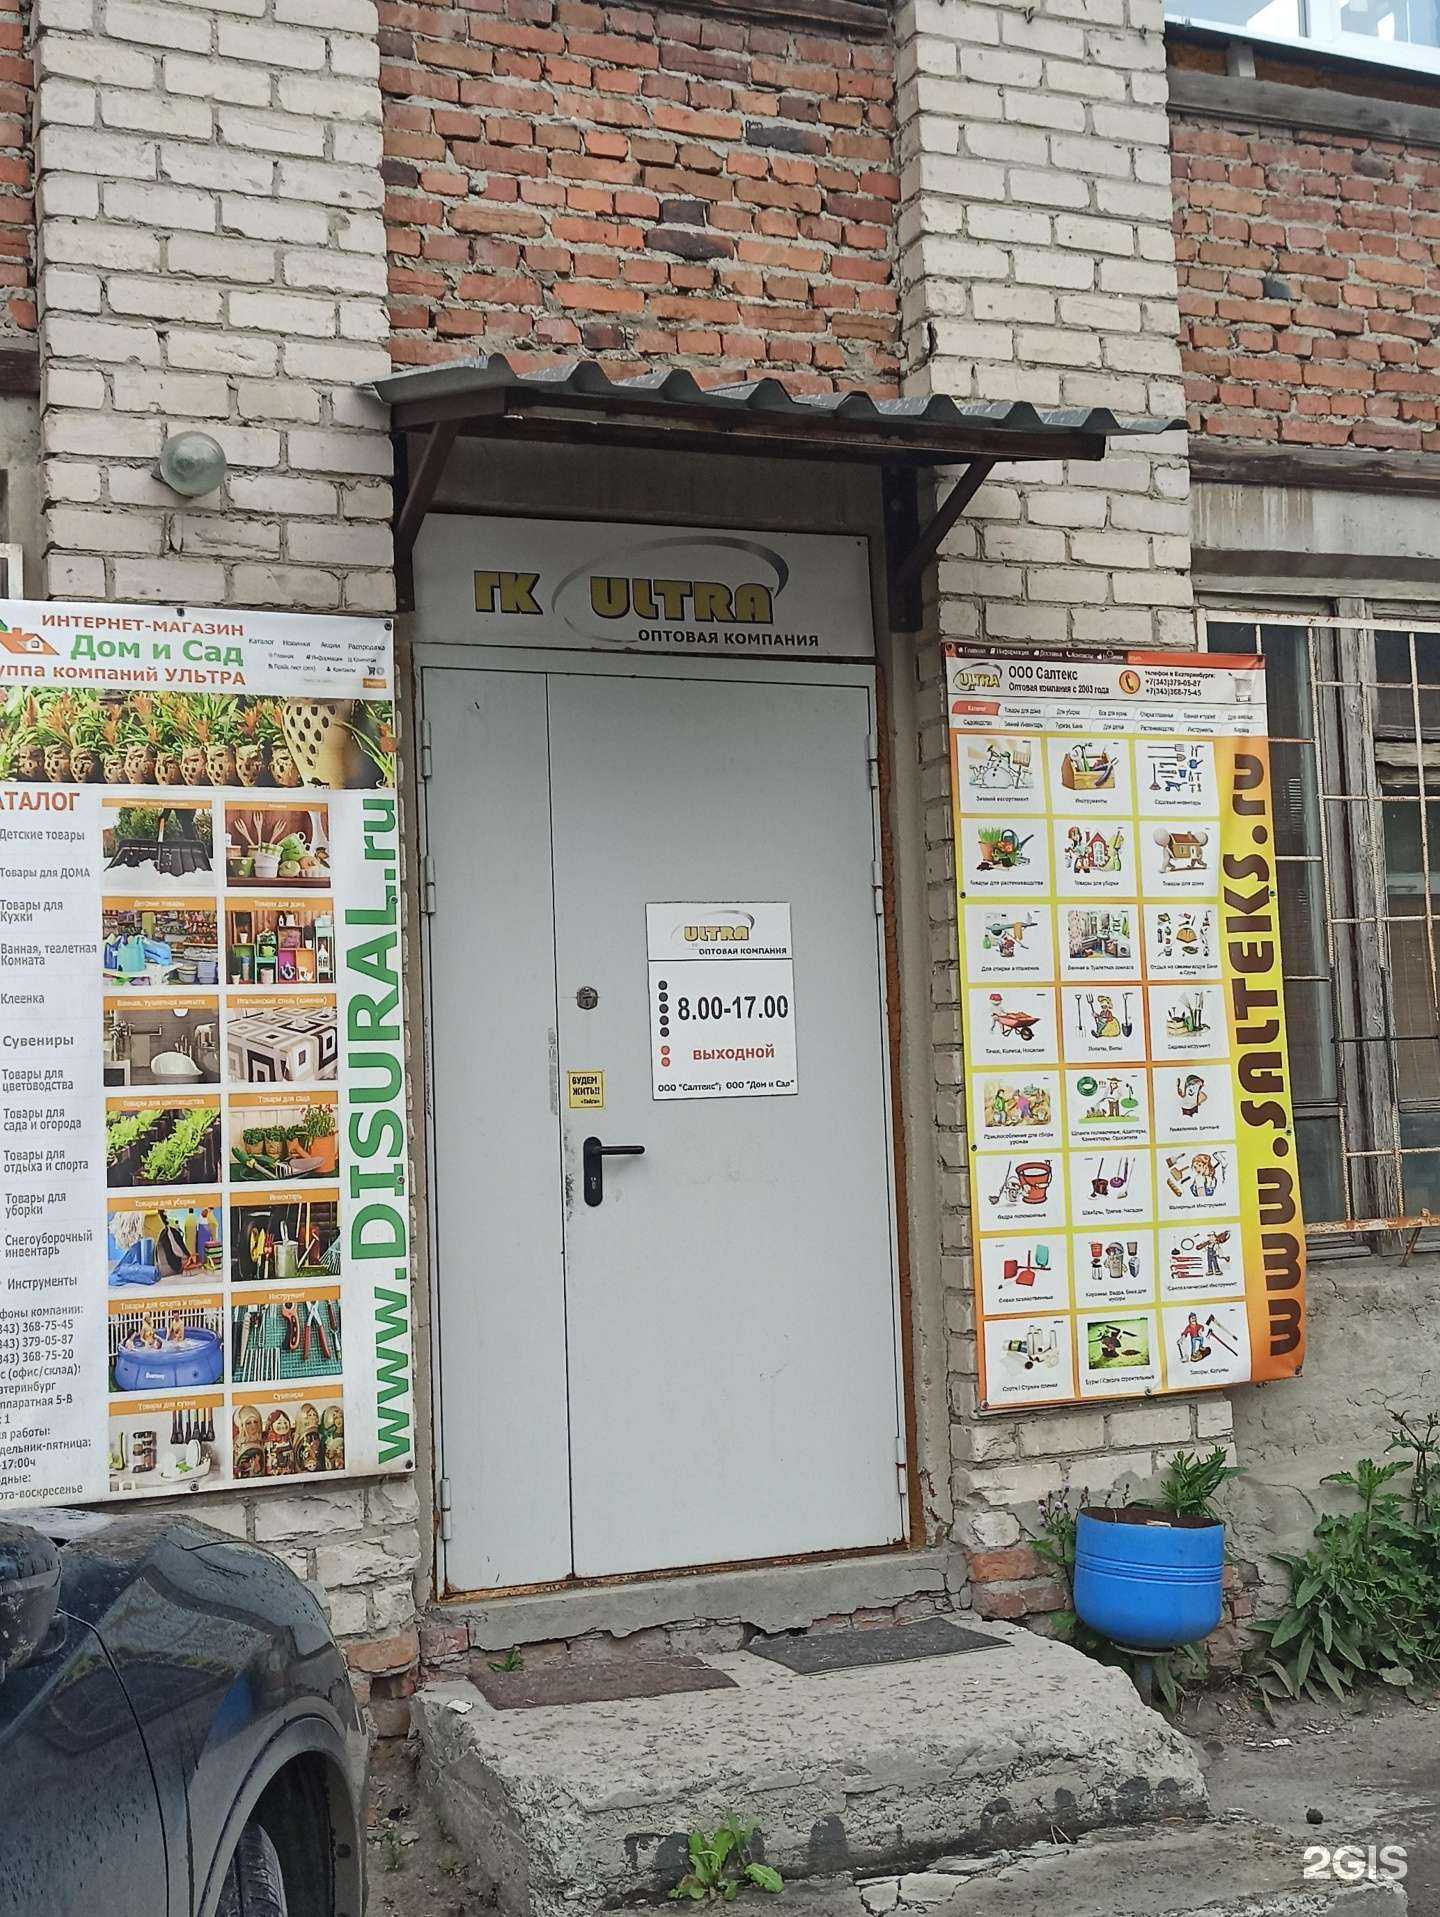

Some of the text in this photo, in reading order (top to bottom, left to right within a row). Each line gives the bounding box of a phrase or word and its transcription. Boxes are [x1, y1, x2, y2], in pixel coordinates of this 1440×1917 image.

[474, 569, 544, 616] ГК
[589, 575, 774, 625] ULTRA
[41, 613, 245, 637] ИНТЕРНЕТ-МАГАЗИН
[638, 629, 819, 647] ОПТОВАЯ КОМПАНИЯ
[69, 634, 244, 667] Дом и Сад
[55, 665, 158, 683] компаний
[165, 669, 246, 686] УЛЬТРА
[960, 672, 1001, 689] ULTRA
[1008, 665, 1079, 681] ООО Салтекс
[1008, 682, 1038, 692] Оптовая
[0, 828, 85, 843] Детские товары
[0, 867, 91, 880] Товары для ДОМА
[0, 899, 64, 912] Товары для
[683, 925, 750, 942] ULTRA
[1, 943, 42, 956] Ванная,
[698, 946, 788, 957] ОПТОВАЯ КОМПАНИЯ
[1, 955, 45, 966] Комната
[0, 993, 44, 1005] Клеенка
[677, 994, 789, 1021] 8.00-17.00
[2, 1034, 74, 1049] Сувениры
[692, 1043, 776, 1061] ВЫХОДНОЙ
[1223, 753, 1301, 1356] www.SALTEKS.ru
[2, 1068, 63, 1082] Товары для
[572, 1076, 598, 1086] БУДЕМ
[2, 1080, 74, 1093] цветоводства
[658, 1083, 677, 1092] ООО
[726, 1080, 745, 1090] ООО
[768, 1080, 774, 1089] и
[3, 1107, 65, 1121] Товары для
[3, 1118, 82, 1132] сада и огорода
[345, 796, 408, 1465] www.DISURAL.ru
[3, 1148, 65, 1163] Товары для
[4, 1159, 89, 1175] отдыха и спорта
[5, 1192, 67, 1206] Товары для
[5, 1204, 43, 1219] уборки
[5, 1229, 93, 1248] Снегоуборочный
[5, 1246, 60, 1259] инвентарь
[7, 1275, 78, 1292] Инструменты
[30, 1305, 84, 1319] компании:
[22, 1319, 74, 1334] 368-75-45
[22, 1334, 74, 1348] 379-05-87
[22, 1349, 74, 1363] 368-75-20
[8, 1362, 81, 1381] (офис/склад):
[56, 1394, 73, 1406] 5-В
[10, 1427, 51, 1442] работы:
